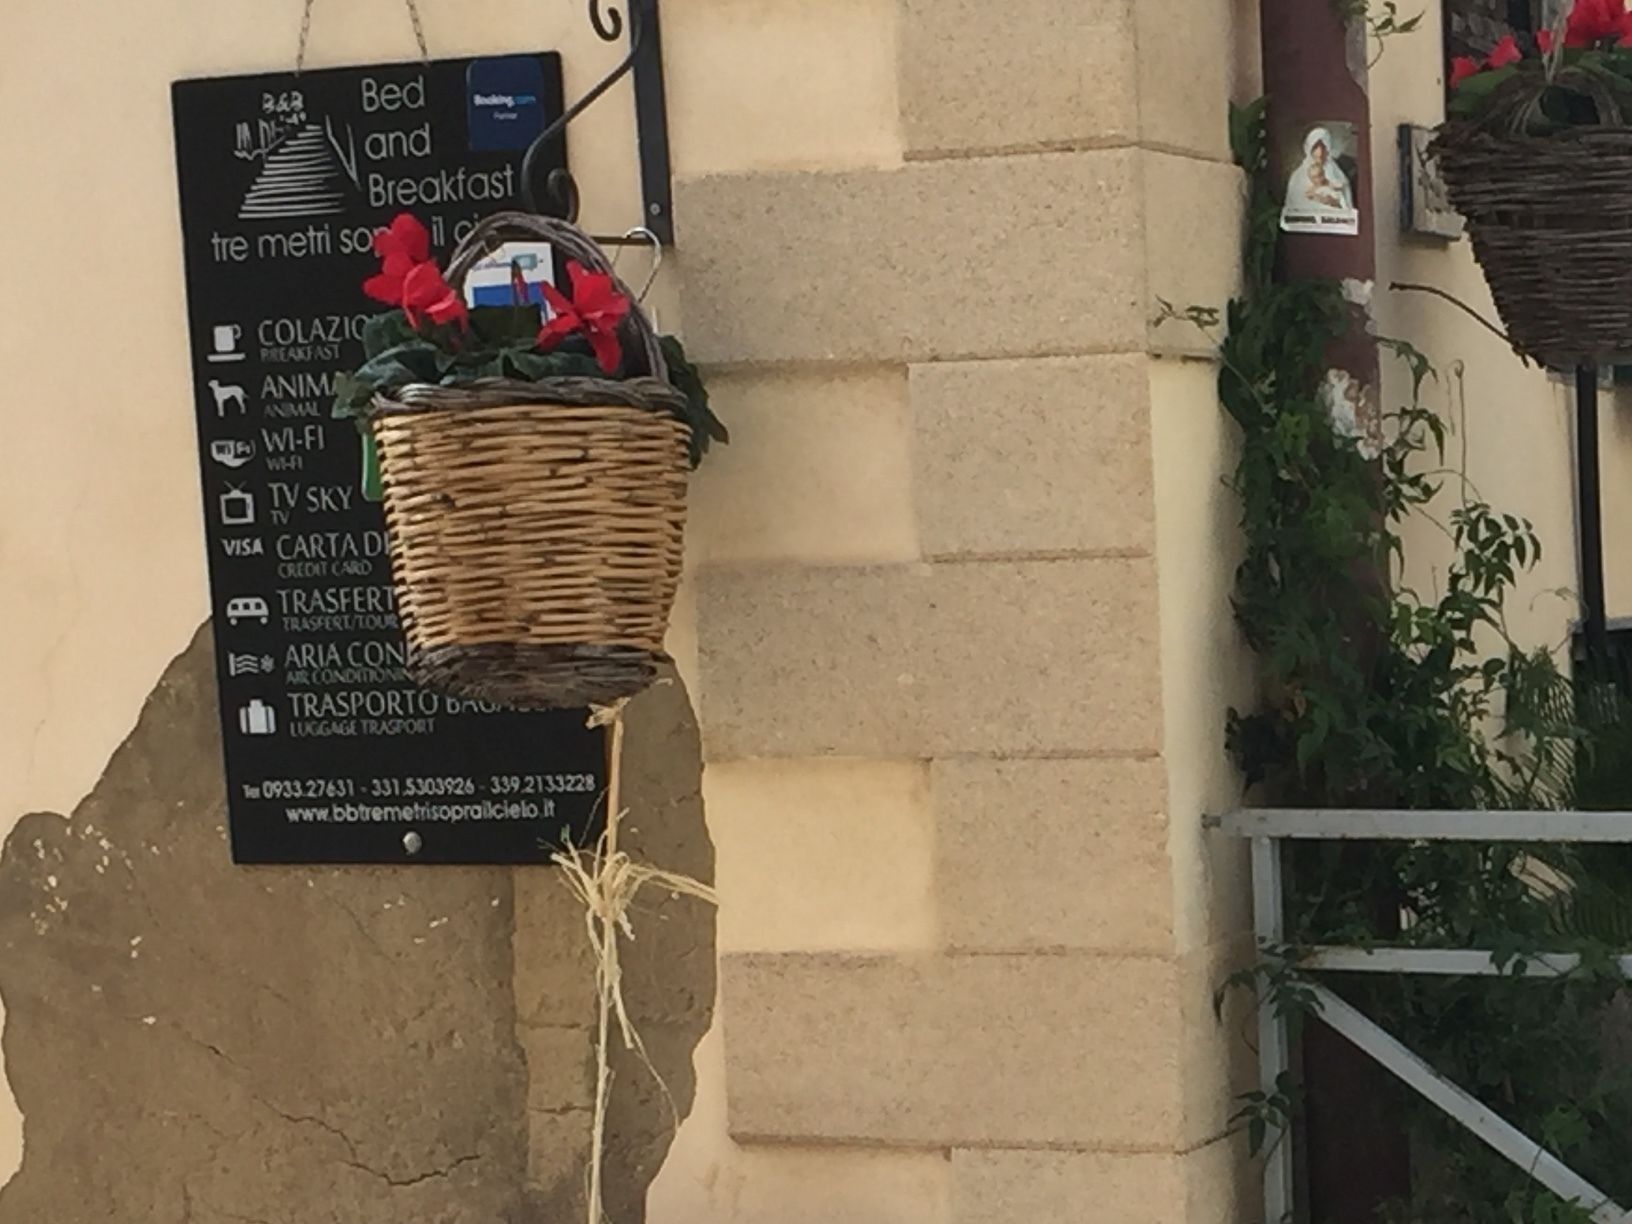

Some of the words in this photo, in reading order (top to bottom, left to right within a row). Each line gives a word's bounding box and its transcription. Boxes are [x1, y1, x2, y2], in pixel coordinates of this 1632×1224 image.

[361, 76, 425, 113] Bed
[365, 122, 431, 160] and
[369, 168, 514, 207] Breakfast
[211, 232, 248, 261] tre
[258, 224, 331, 258] metri
[432, 216, 444, 246] il
[258, 315, 368, 346] COLAZIO
[260, 344, 340, 362] BREAKFAST
[263, 401, 321, 418] ANIMAL
[261, 425, 325, 452] WI-FI
[266, 456, 303, 471] WI-FI
[267, 482, 300, 508] TV
[306, 485, 353, 512] SKY
[270, 510, 290, 526] TV
[221, 538, 264, 556] VISA
[276, 532, 358, 560] CARTA
[278, 561, 328, 579] CREDIT
[332, 559, 372, 577] CARD
[284, 642, 342, 668] ARIA
[286, 670, 310, 686] AIR
[287, 690, 439, 718] TRASPORTO
[290, 719, 357, 737] LUGGAGE
[361, 717, 436, 736] TRASPORT
[262, 779, 354, 799] 0933.27631
[372, 776, 475, 797] 331.5303926
[491, 773, 596, 795] 339.2133228
